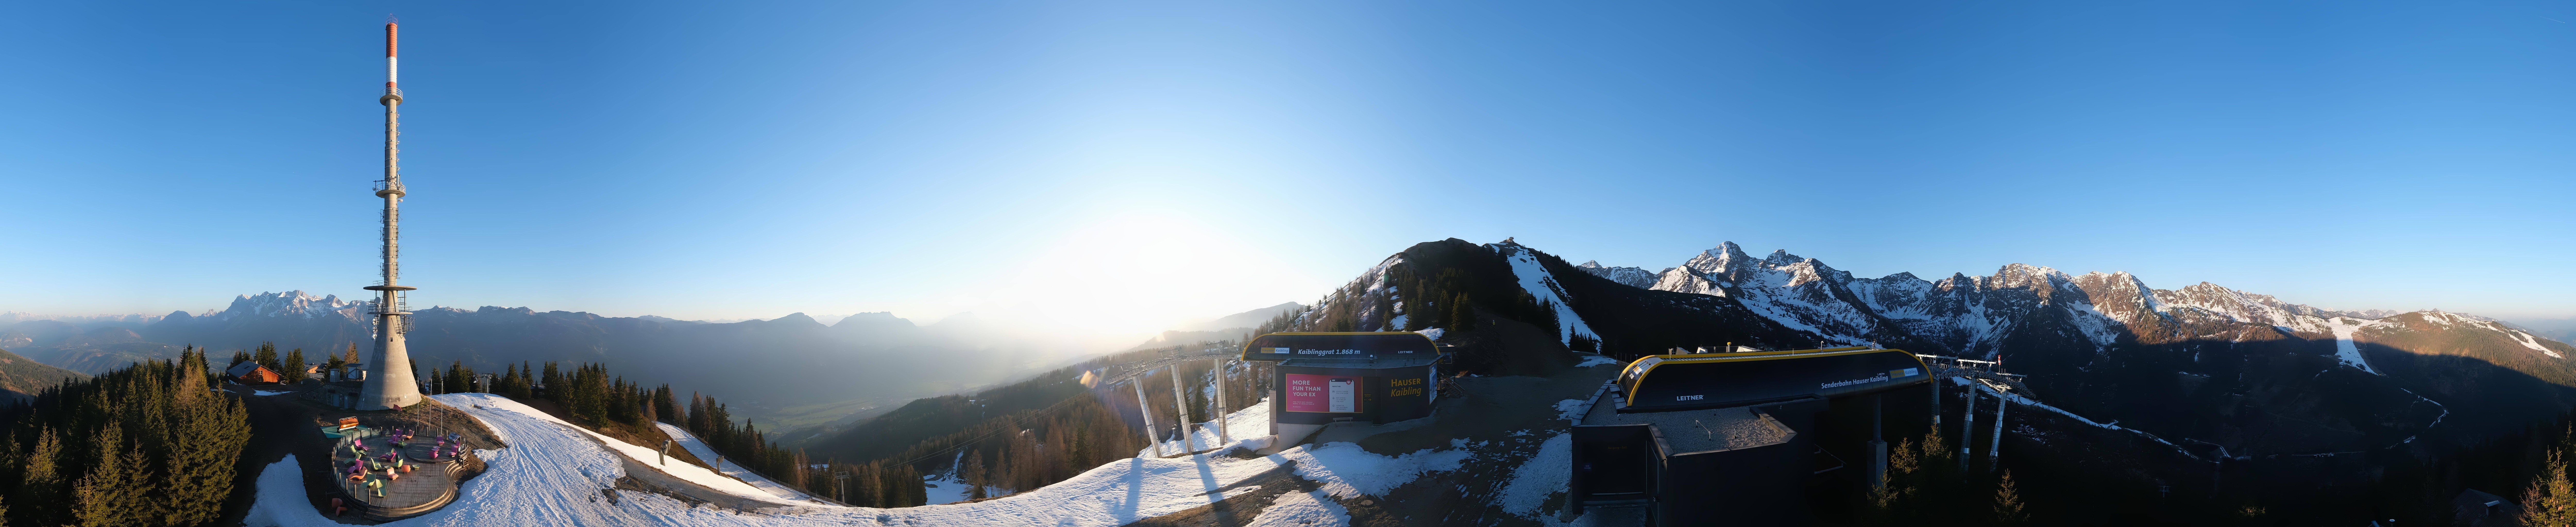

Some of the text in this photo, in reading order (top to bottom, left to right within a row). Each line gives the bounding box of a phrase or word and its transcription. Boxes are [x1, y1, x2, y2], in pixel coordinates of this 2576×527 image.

[1391, 378, 1421, 387] HAUSER
[1821, 380, 1852, 389] Senderbahn
[1391, 387, 1421, 397] Kaibling
